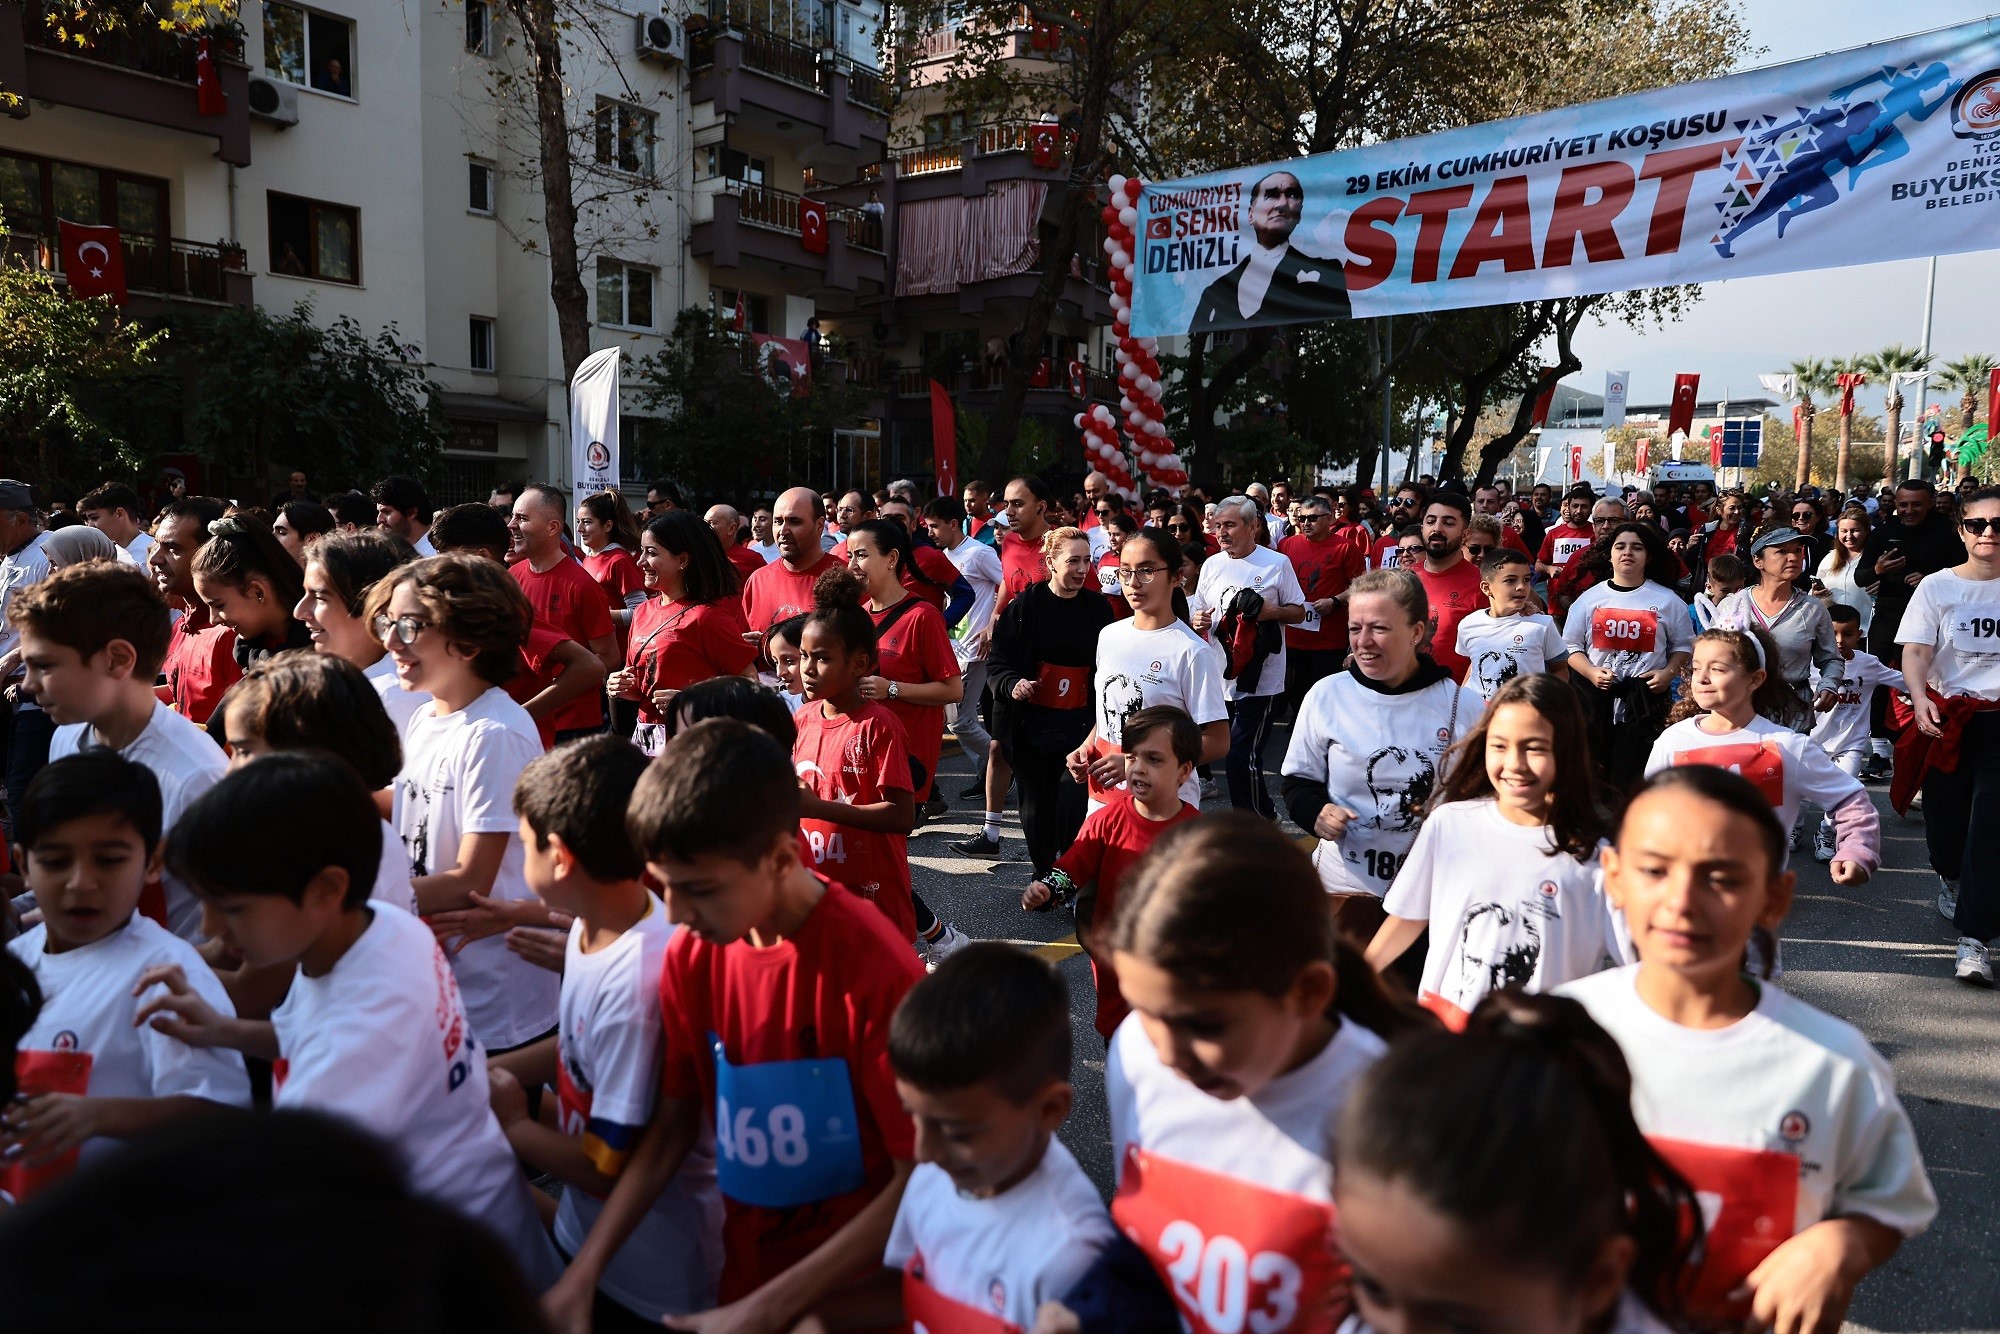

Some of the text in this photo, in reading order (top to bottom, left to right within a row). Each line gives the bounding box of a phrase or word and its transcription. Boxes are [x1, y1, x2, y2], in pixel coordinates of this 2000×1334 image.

[1345, 109, 1728, 195] 29 EKİM CUMHURİYET KOŞUSU
[1149, 182, 1242, 214] CUMHURİYET
[1343, 139, 1744, 290] START
[1175, 204, 1239, 240] ŞEHRİ
[1149, 235, 1239, 274] DENİZLİ
[1604, 619, 1641, 640] 303
[1970, 617, 2000, 638] 19
[1058, 678, 1070, 697] 9
[1159, 1219, 1302, 1334] 203
